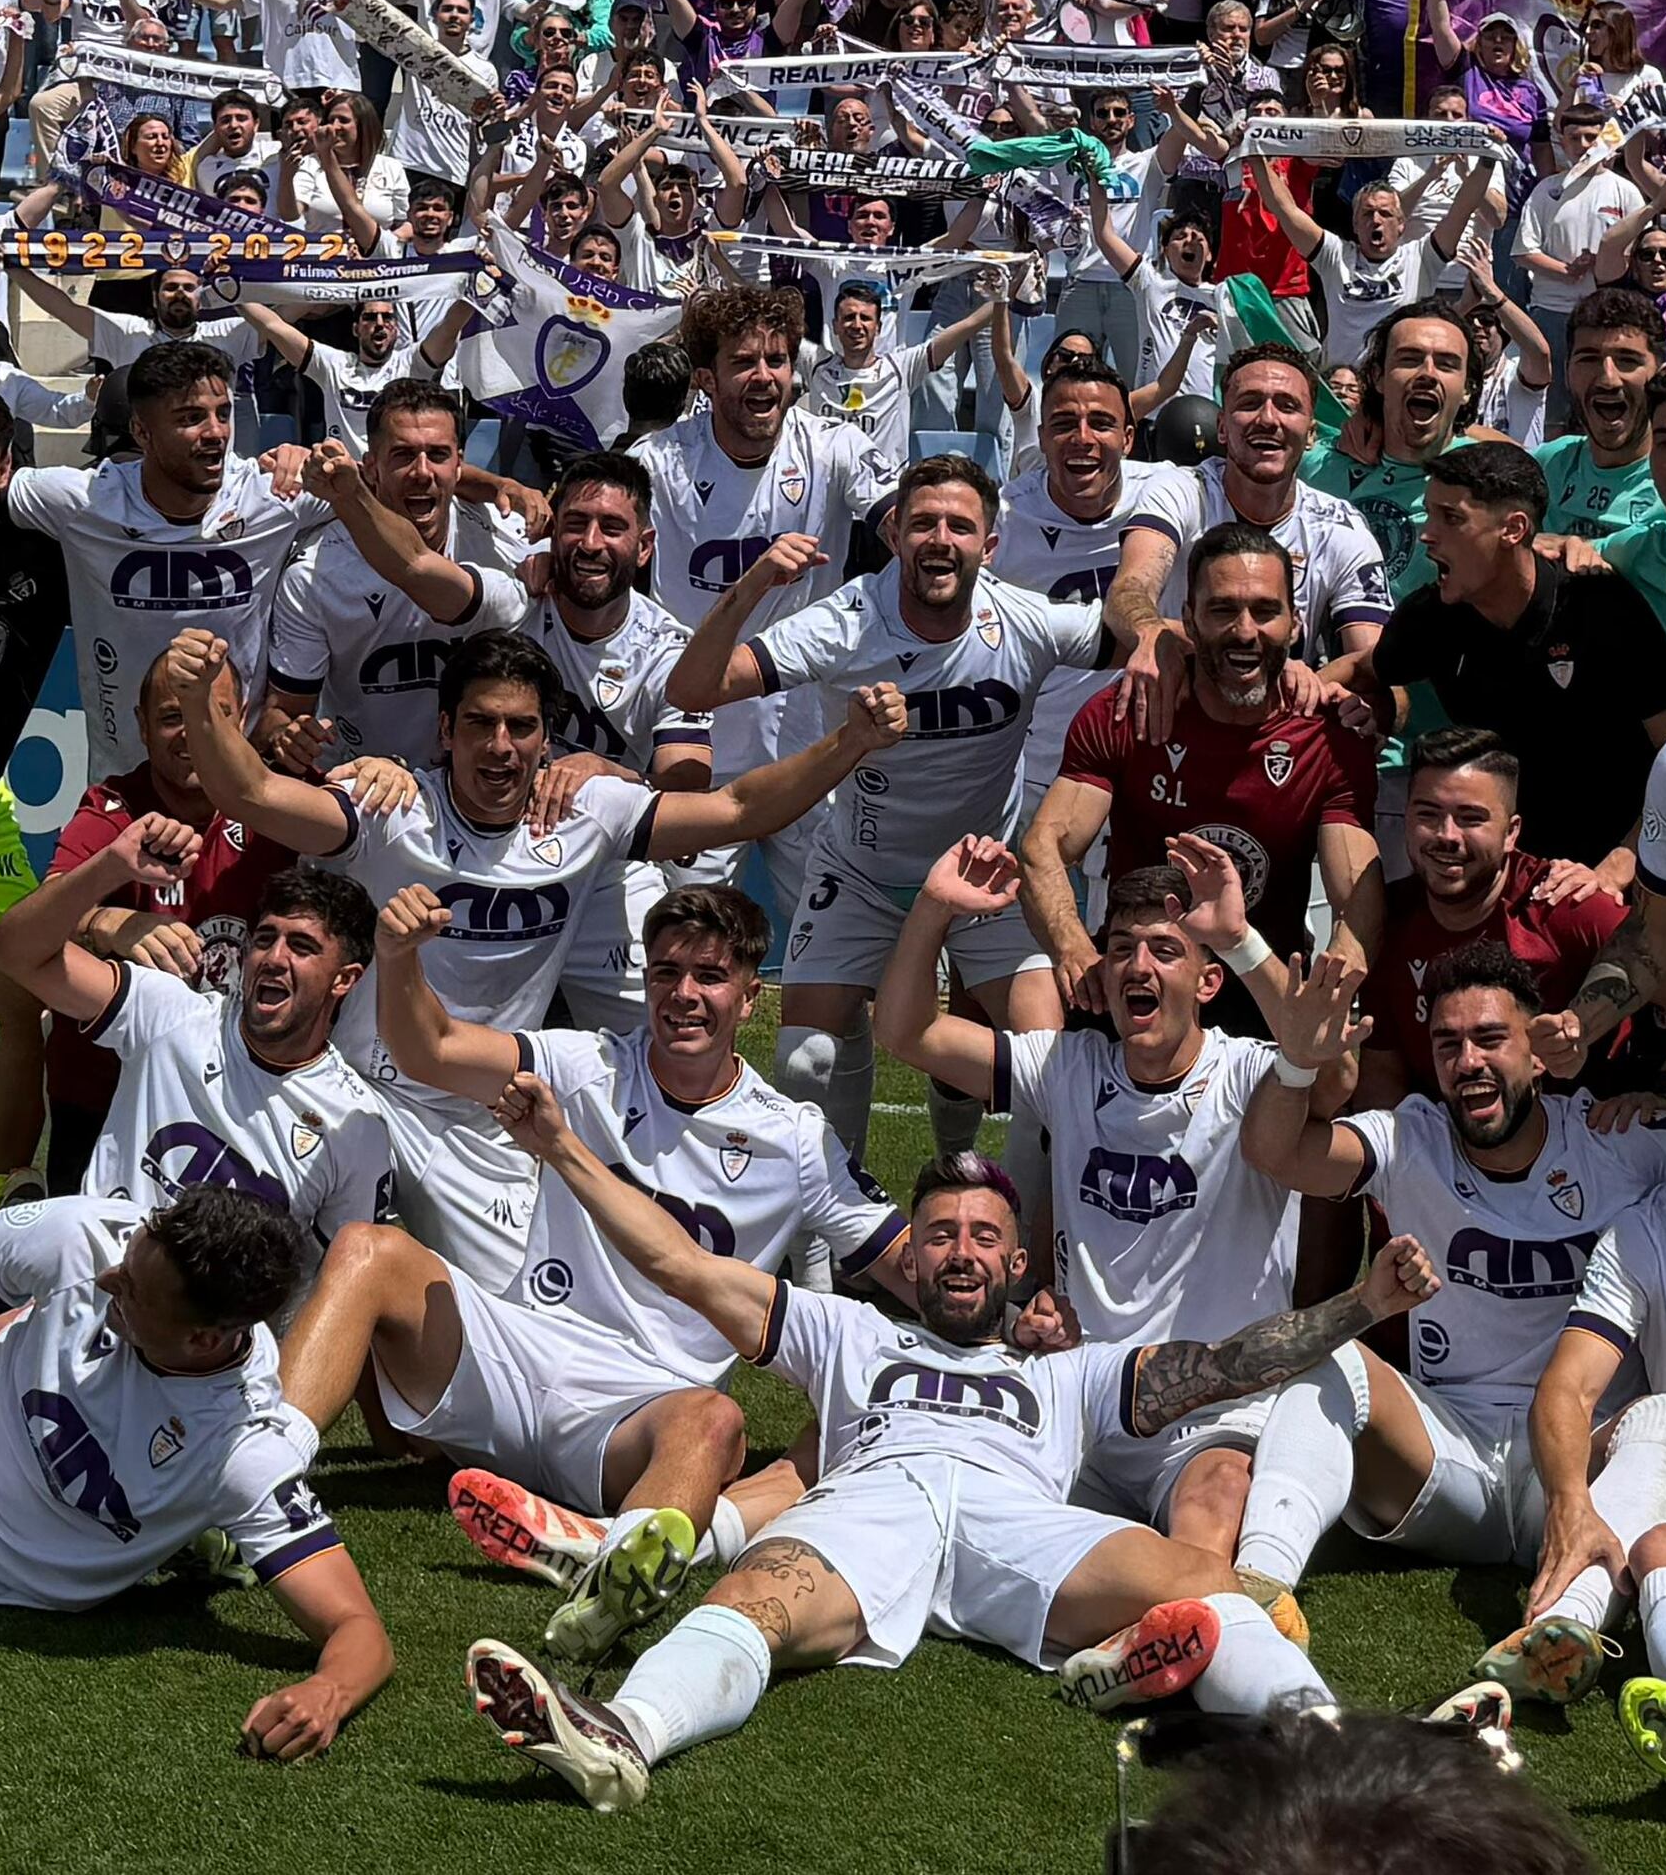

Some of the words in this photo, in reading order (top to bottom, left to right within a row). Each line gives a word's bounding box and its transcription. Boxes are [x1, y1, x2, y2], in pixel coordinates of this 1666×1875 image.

[768, 63, 834, 86] REAL
[1404, 126, 1434, 138] UN
[788, 149, 857, 174] REAL
[134, 178, 201, 215] REAL
[13, 229, 146, 269] 1922
[1586, 485, 1611, 510] 25
